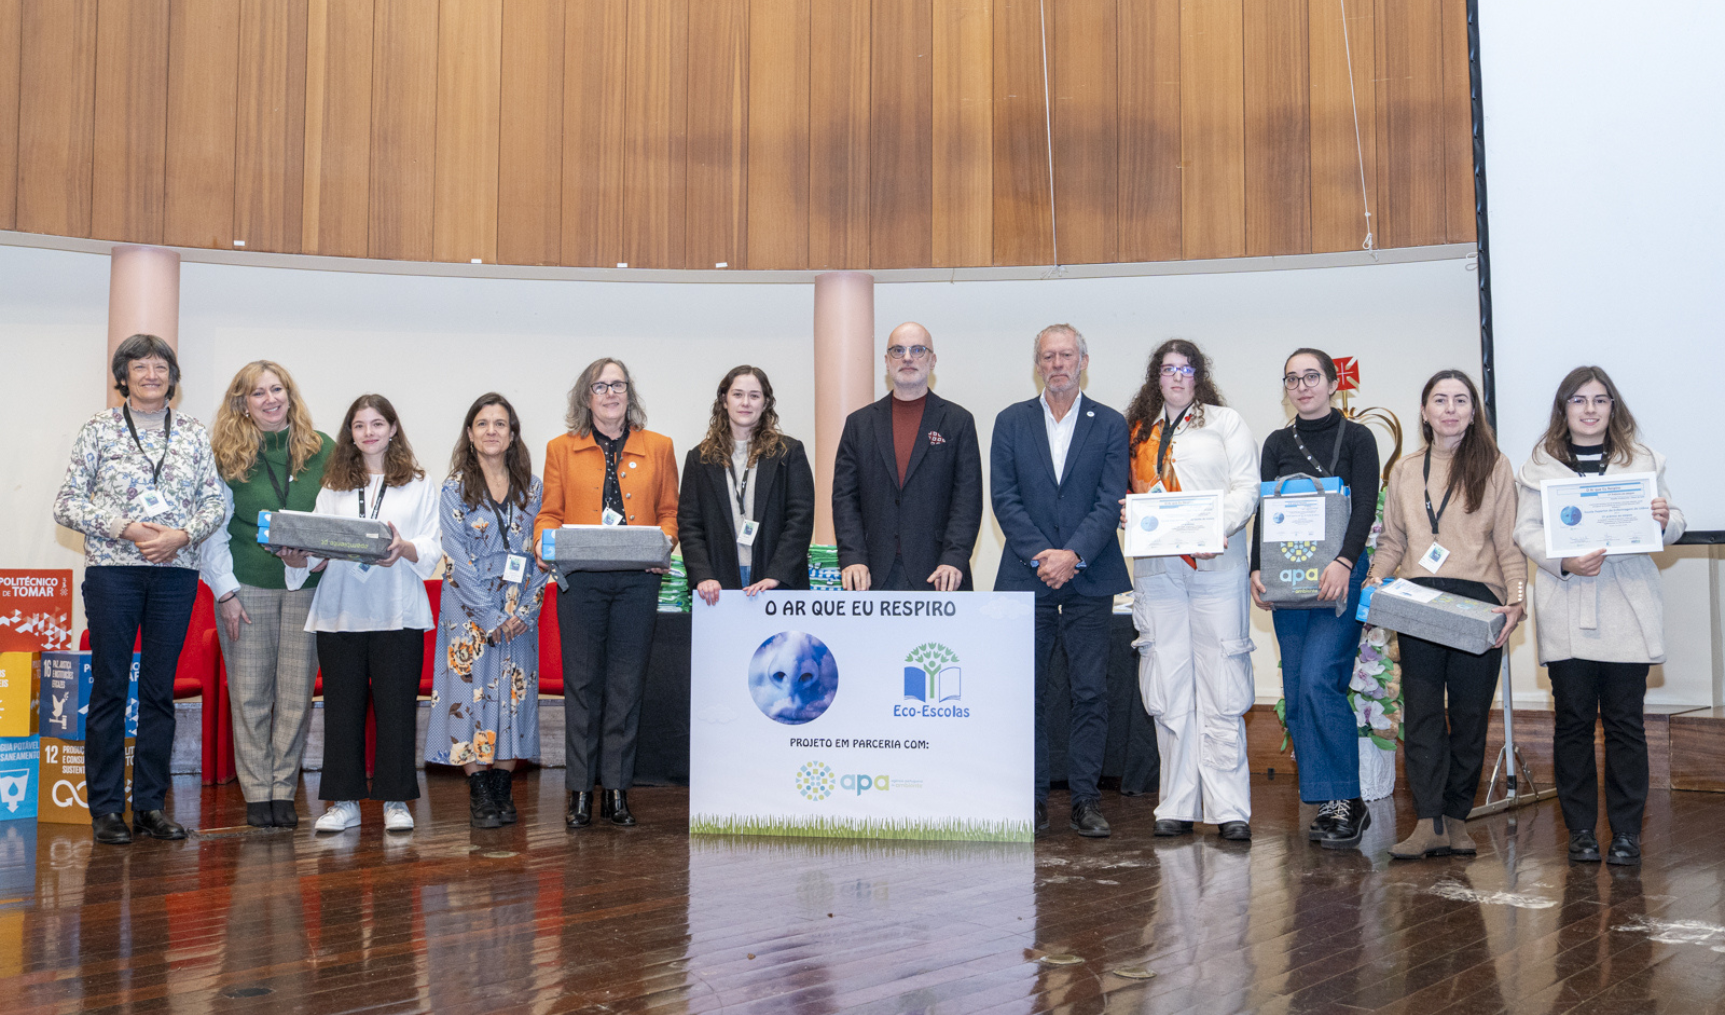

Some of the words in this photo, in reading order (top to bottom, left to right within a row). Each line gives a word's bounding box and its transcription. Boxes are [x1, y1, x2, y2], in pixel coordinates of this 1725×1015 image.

[0, 576, 58, 586] POLITÉCNICO
[1280, 568, 1318, 586] apa
[12, 586, 54, 597] TOMAR
[765, 600, 777, 616] O
[783, 600, 806, 616] AR
[812, 600, 846, 616] QUE
[852, 601, 873, 616] EU
[880, 601, 956, 617] RESPIRO
[893, 704, 970, 718] Eco-Escolas
[0, 743, 13, 752] GUA
[790, 738, 832, 748] PROJETO
[835, 738, 849, 748] EM
[853, 739, 901, 749] PARCERIA
[904, 739, 929, 749] COM:
[45, 744, 58, 764] 12
[62, 745, 85, 755] PRODUÇ
[62, 755, 66, 764] E
[66, 755, 85, 764] CONSU
[62, 765, 85, 774] SUSTENT
[840, 774, 889, 796] apa
